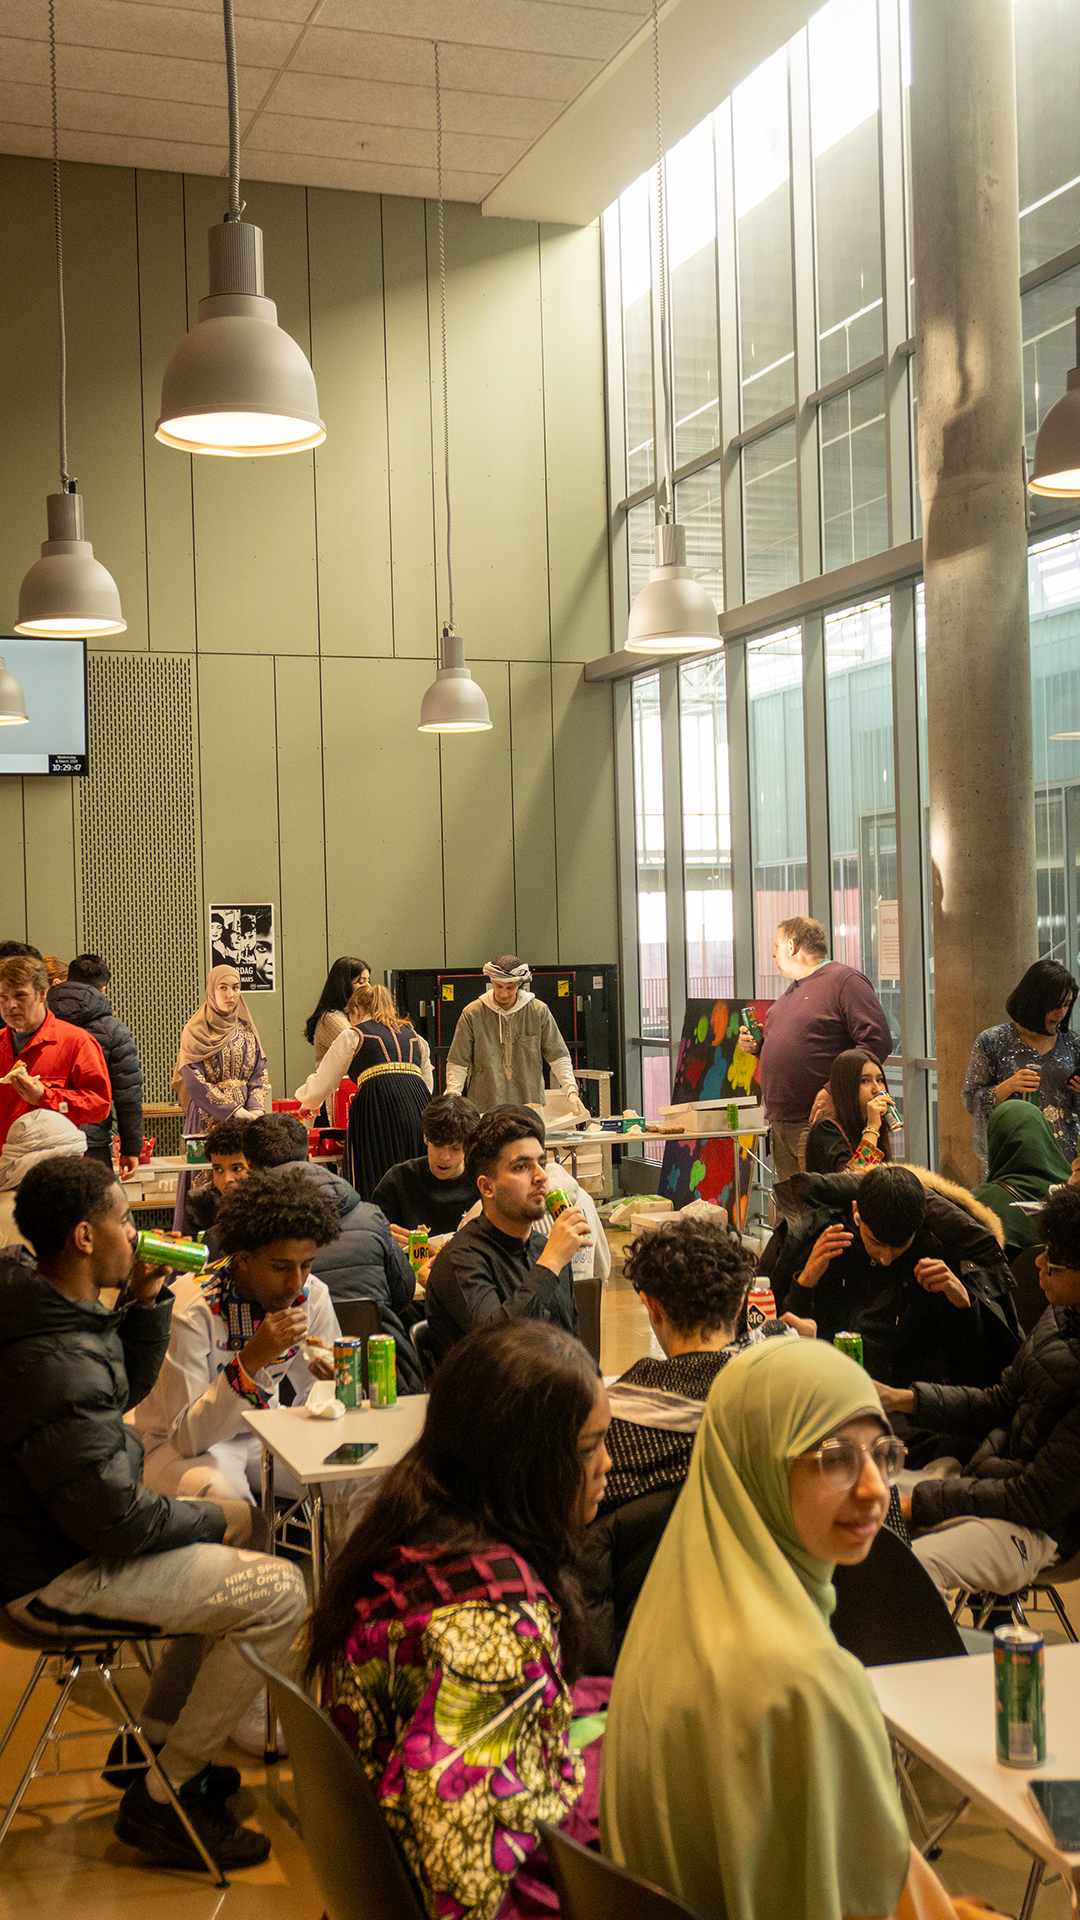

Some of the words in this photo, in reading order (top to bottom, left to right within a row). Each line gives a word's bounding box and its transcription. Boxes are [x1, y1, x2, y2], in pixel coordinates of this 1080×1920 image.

[205, 1590, 228, 1605] KE,
[256, 1572, 280, 1586] One
[225, 1567, 254, 1587] NIKE
